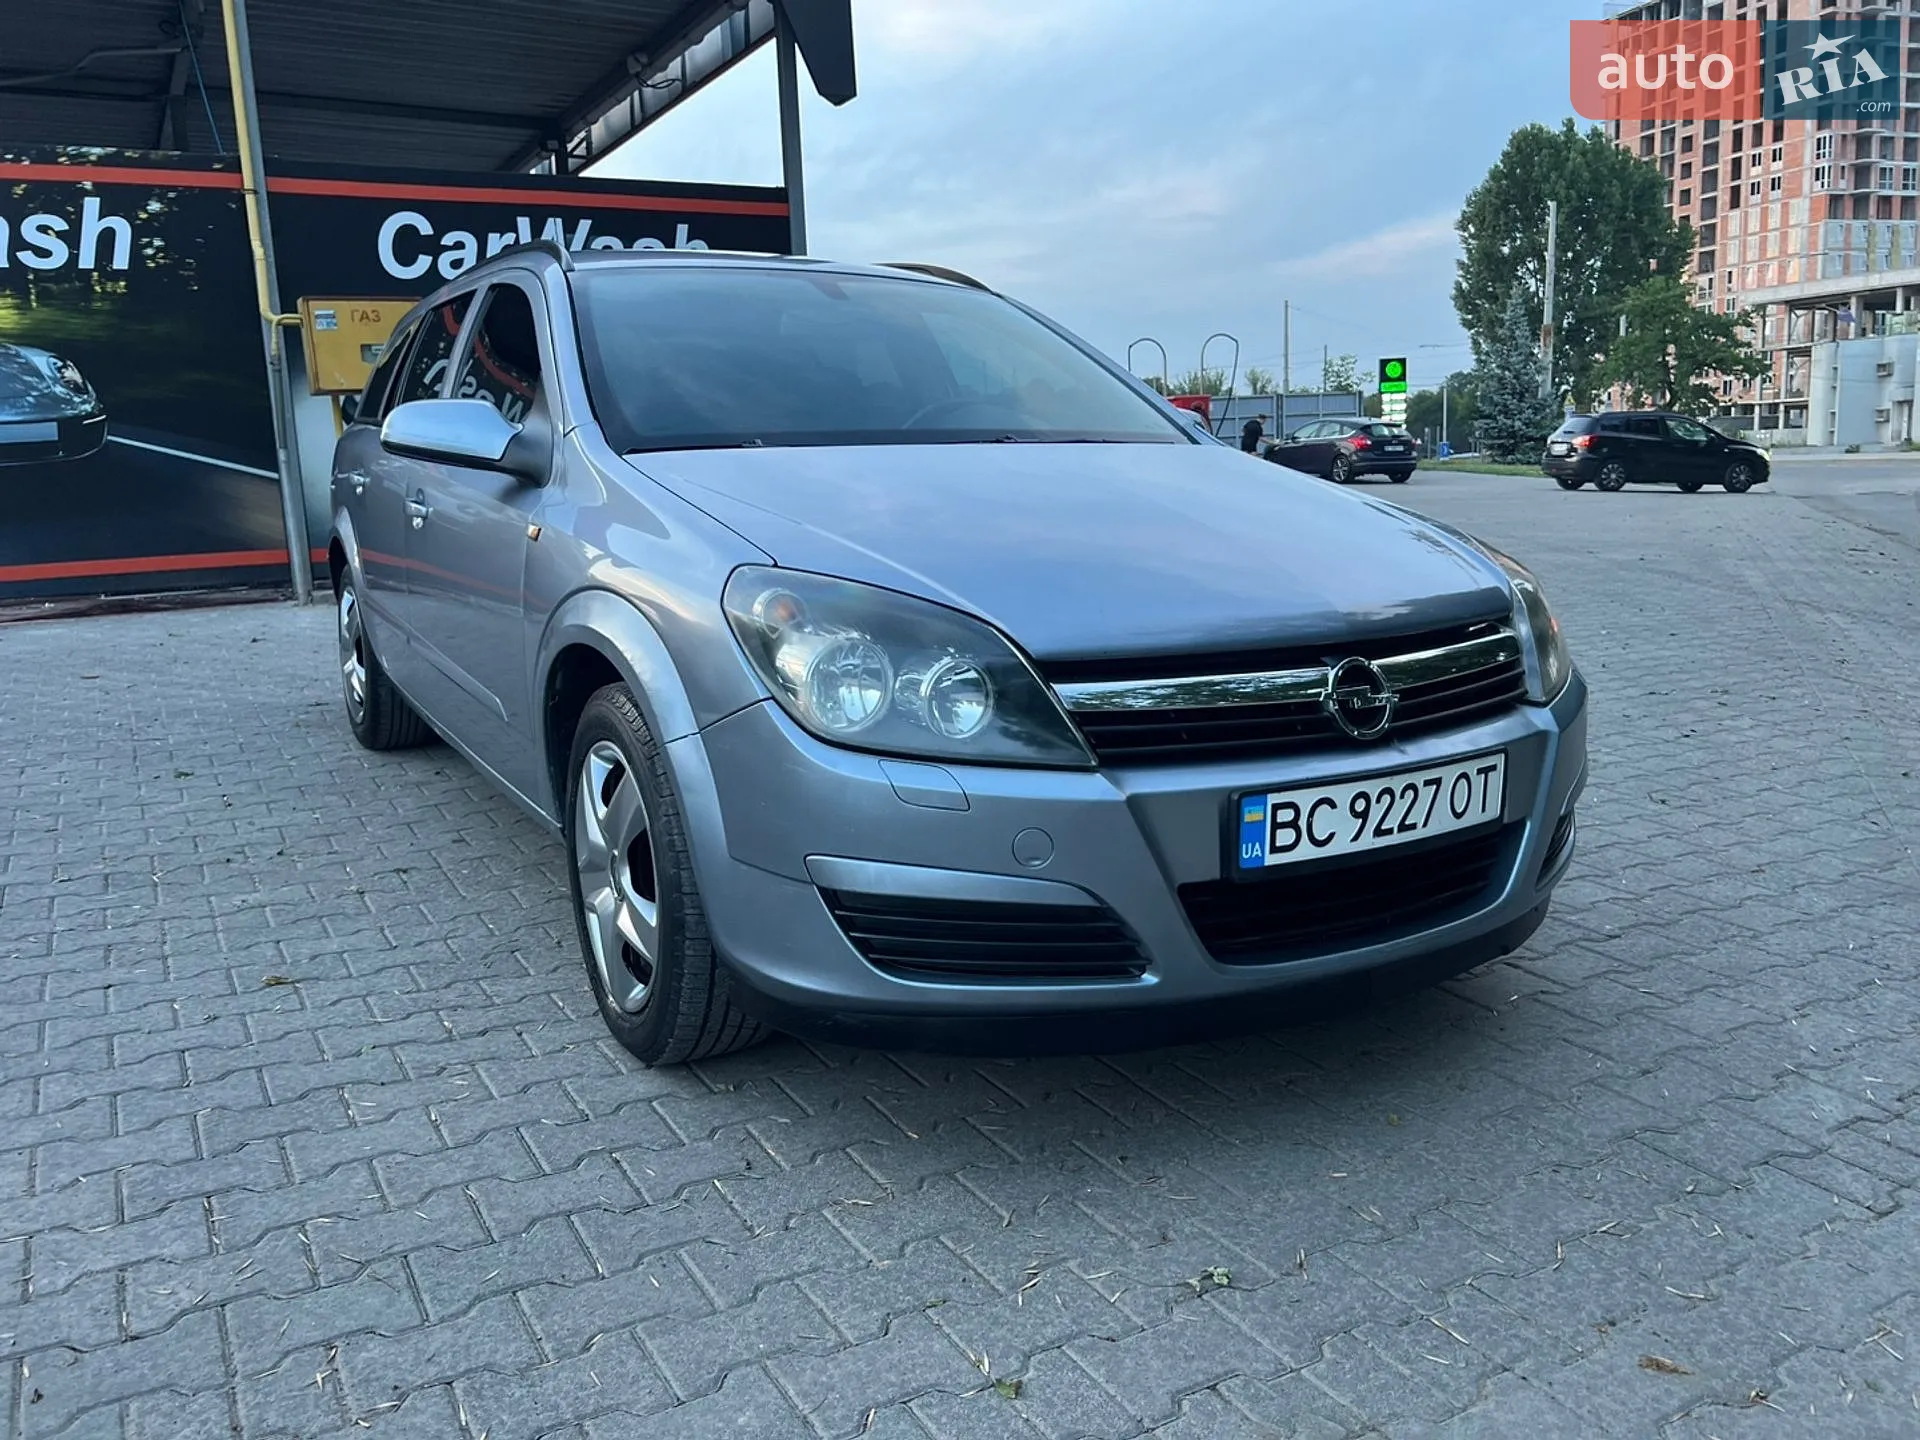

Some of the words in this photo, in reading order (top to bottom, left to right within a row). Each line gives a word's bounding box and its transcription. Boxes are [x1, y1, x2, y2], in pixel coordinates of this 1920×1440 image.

[0, 196, 133, 270] sh
[350, 308, 382, 323] ГАЗ
[1269, 796, 1338, 856] BC
[1349, 775, 1443, 843] 9227
[1449, 763, 1498, 821] OT
[1242, 841, 1263, 860] UA
